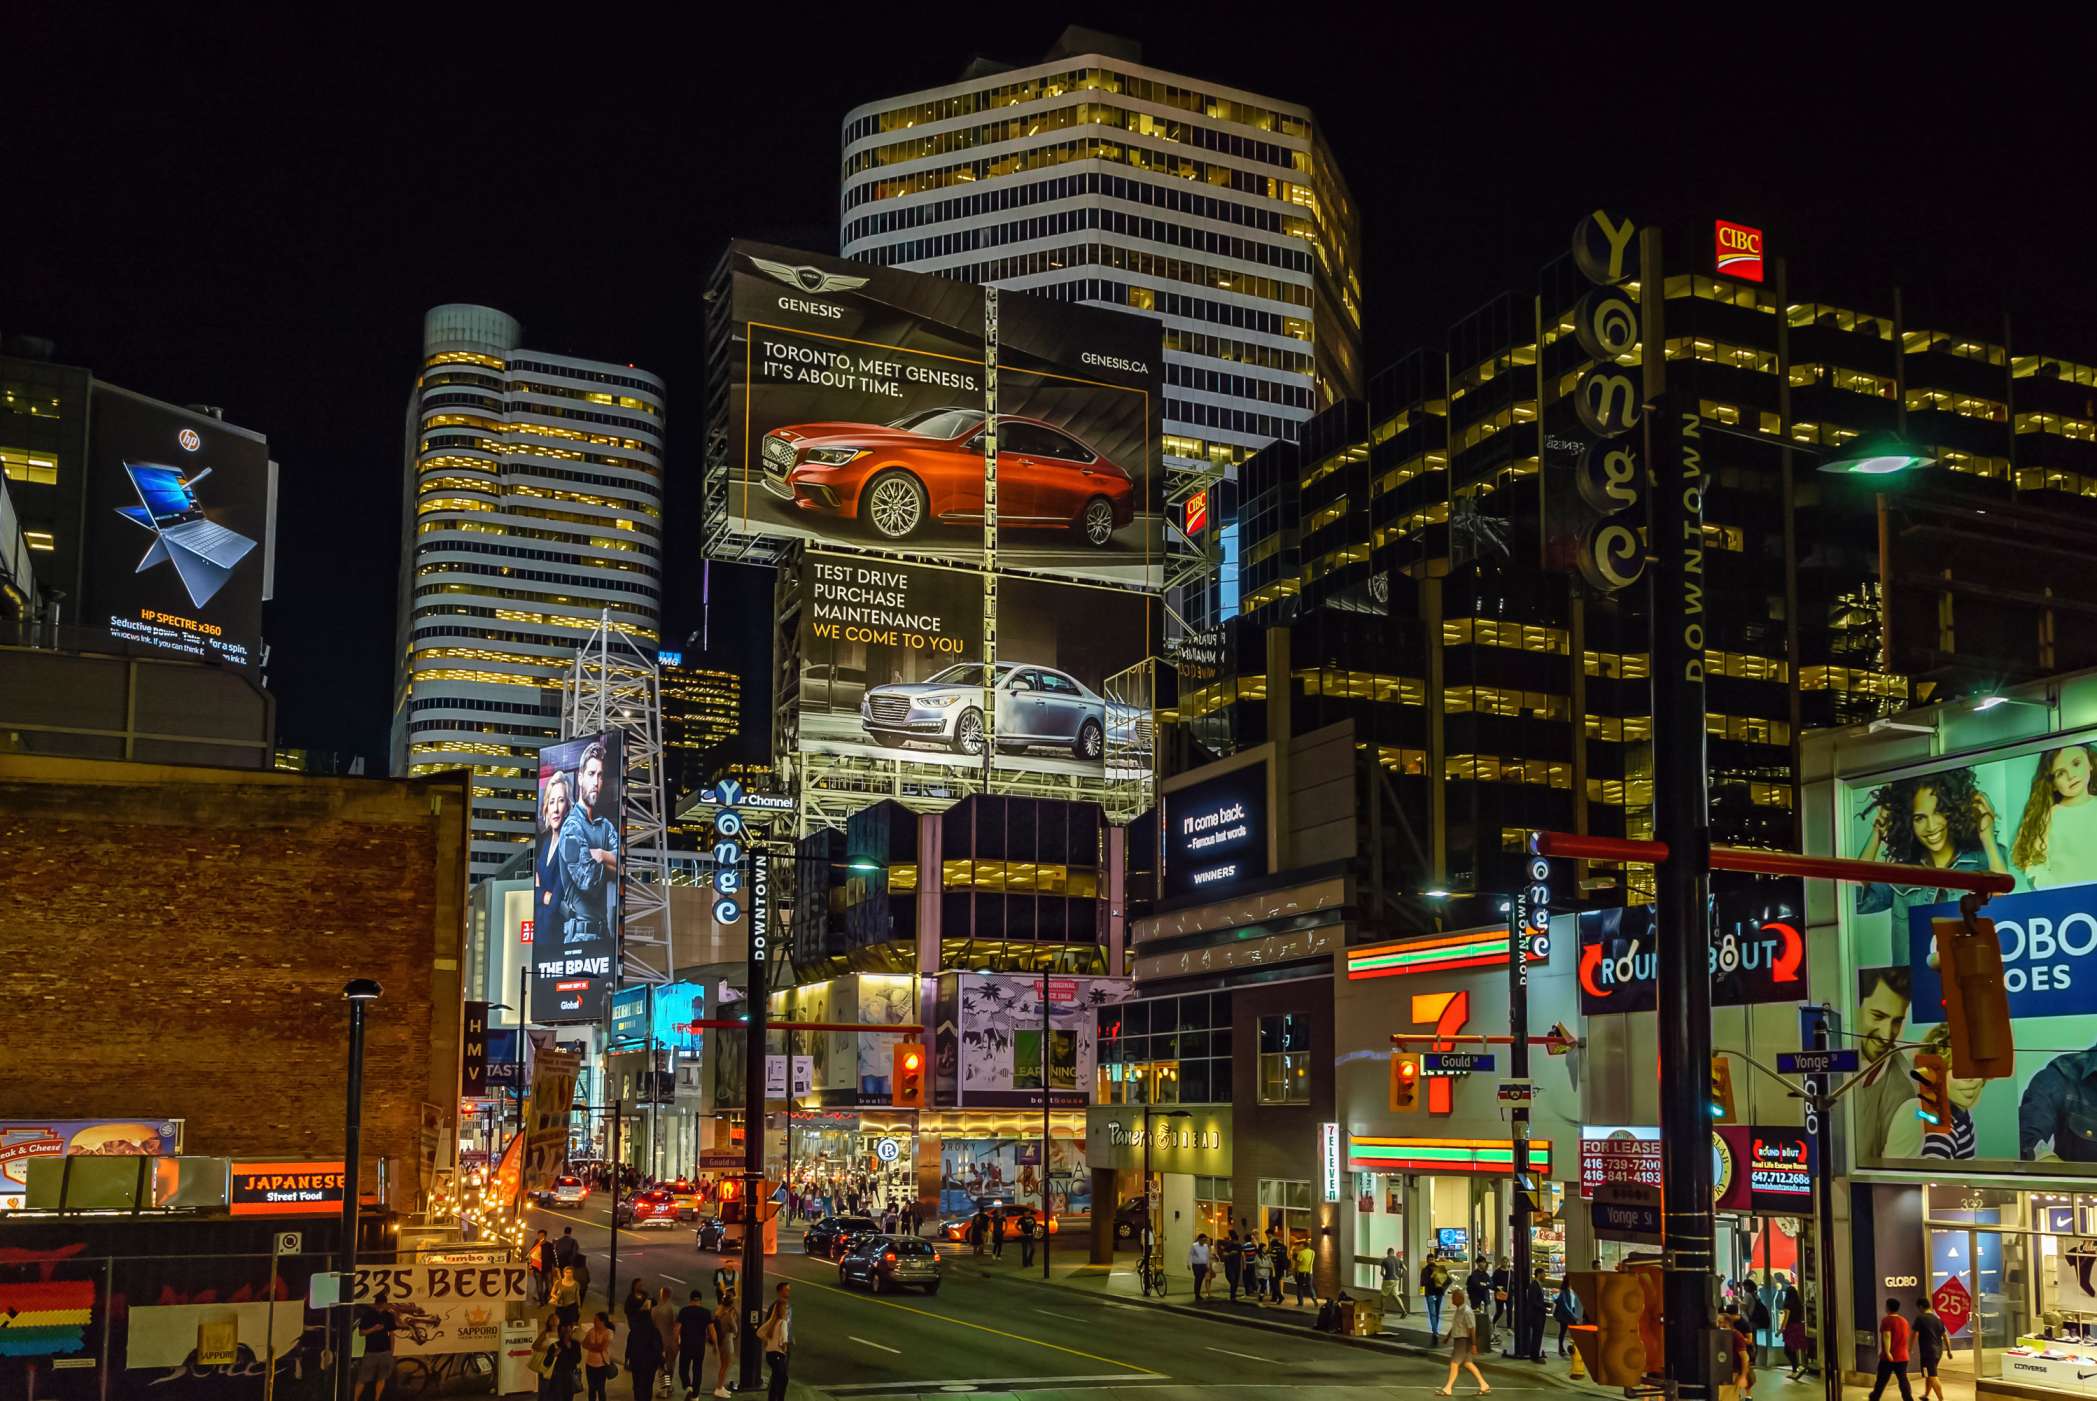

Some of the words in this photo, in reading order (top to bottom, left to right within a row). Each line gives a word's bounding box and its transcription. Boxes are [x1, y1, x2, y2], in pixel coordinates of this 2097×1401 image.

[1718, 226, 1759, 255] CIBC
[778, 297, 842, 319] GENESIS
[763, 341, 855, 373] TORONTO,
[859, 357, 903, 379] MEET
[906, 365, 980, 392] GENESIS.
[1081, 352, 1149, 375] GENESIS.CA
[763, 361, 794, 380] IT'S
[797, 366, 855, 390] ABOUT
[859, 378, 904, 398] TIME.
[1187, 492, 1207, 515] CIBC
[1680, 411, 1704, 685] DOWNTOWN
[814, 563, 854, 582] TEST
[857, 568, 908, 589] DRIVE
[814, 583, 905, 608] PURCHASE
[110, 616, 152, 634] Seductive
[141, 608, 156, 620] HP
[156, 613, 198, 631] SPECTRE
[198, 623, 222, 636] x360
[813, 603, 941, 632] MAINTENANCE
[813, 623, 840, 640] WE
[845, 627, 898, 647] COME
[902, 633, 926, 648] TO
[928, 635, 965, 654] YOU
[748, 795, 793, 808] Channel
[1194, 813, 1219, 832] come
[713, 779, 743, 925] Yonge
[1193, 865, 1235, 884] WINNERS
[754, 855, 767, 960] DOWNTOWN
[1519, 894, 1529, 986] DOWNTOWN
[538, 961, 564, 979] THE
[565, 956, 610, 976] BRAVE
[561, 999, 579, 1010] Global
[1412, 991, 1470, 1115] 7
[1441, 1055, 1471, 1068] Gould
[1794, 1055, 1829, 1072] Yonge
[1328, 1125, 1334, 1136] 7
[18, 1145, 27, 1154] &
[28, 1142, 63, 1154] Cheese
[1583, 1141, 1610, 1153] FOR
[1613, 1142, 1661, 1154] LEASE
[1583, 1158, 1661, 1171] 416-739-7200
[244, 1174, 345, 1191] JAPANESE
[1583, 1170, 1661, 1183] 416-841-4193
[266, 1191, 298, 1202] Street
[299, 1191, 322, 1201] Food
[1607, 1207, 1639, 1229] Yonge
[427, 1268, 526, 1298] BEER
[1885, 1276, 1918, 1288] GLOBO
[1938, 1292, 1962, 1316] 25
[457, 1326, 498, 1336] SAPPORO
[505, 1336, 533, 1345] PARKING
[2014, 1362, 2048, 1374] CONVERSE
